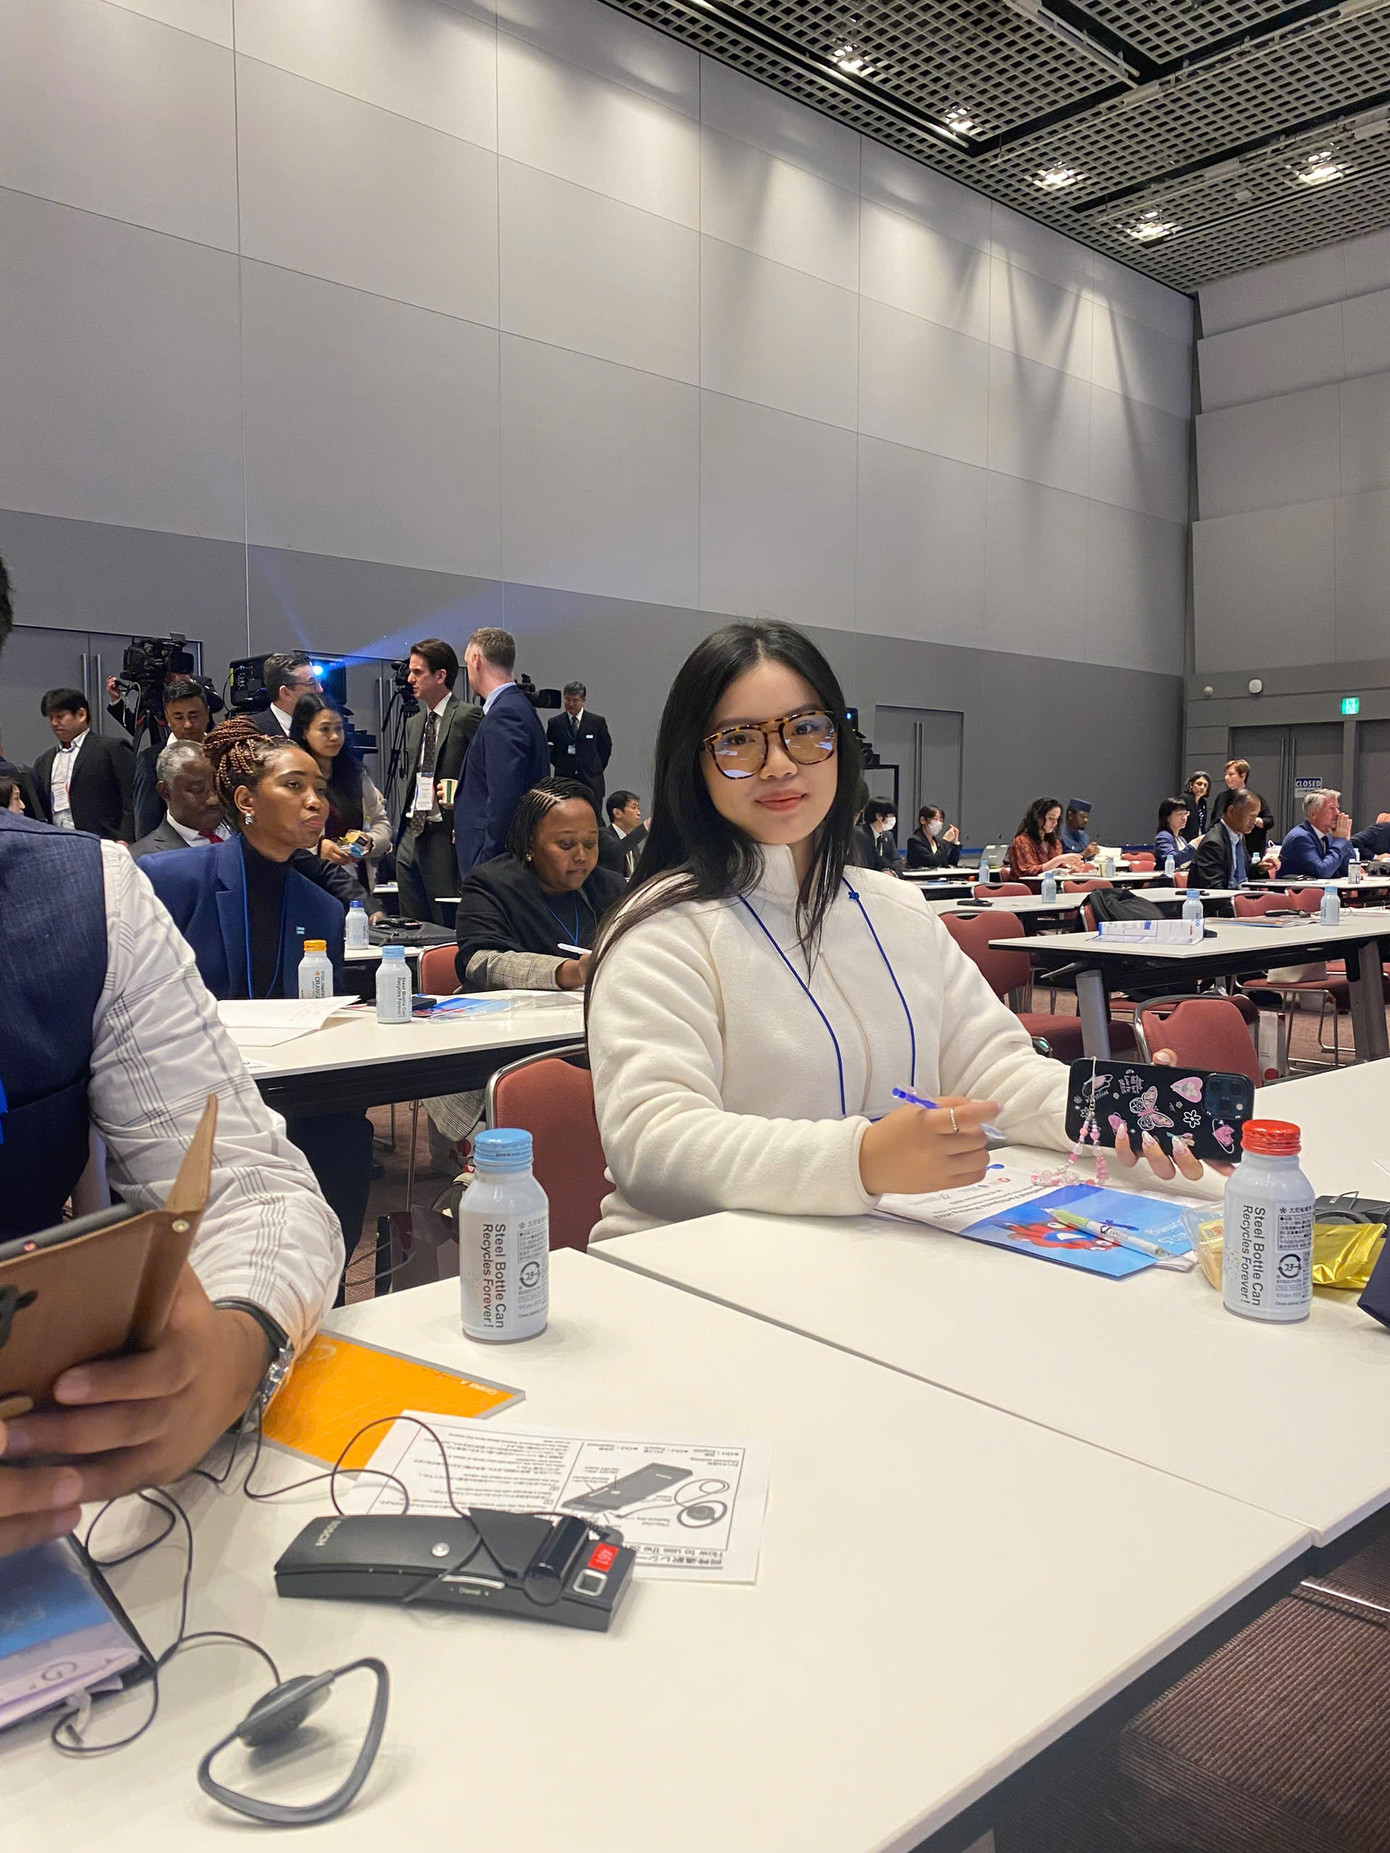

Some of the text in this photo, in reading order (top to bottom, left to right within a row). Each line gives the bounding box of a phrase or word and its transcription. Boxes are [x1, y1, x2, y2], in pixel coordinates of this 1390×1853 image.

[1296, 780, 1321, 788] CLOSED
[480, 1223, 494, 1328] Recycles Forever!
[495, 1223, 507, 1329] Steel Bottle Can
[1240, 1204, 1253, 1304] Recycles Forever!
[1251, 1207, 1266, 1306] Steel Bottle Can
[643, 1547, 660, 1555] the
[699, 1550, 723, 1558] How
